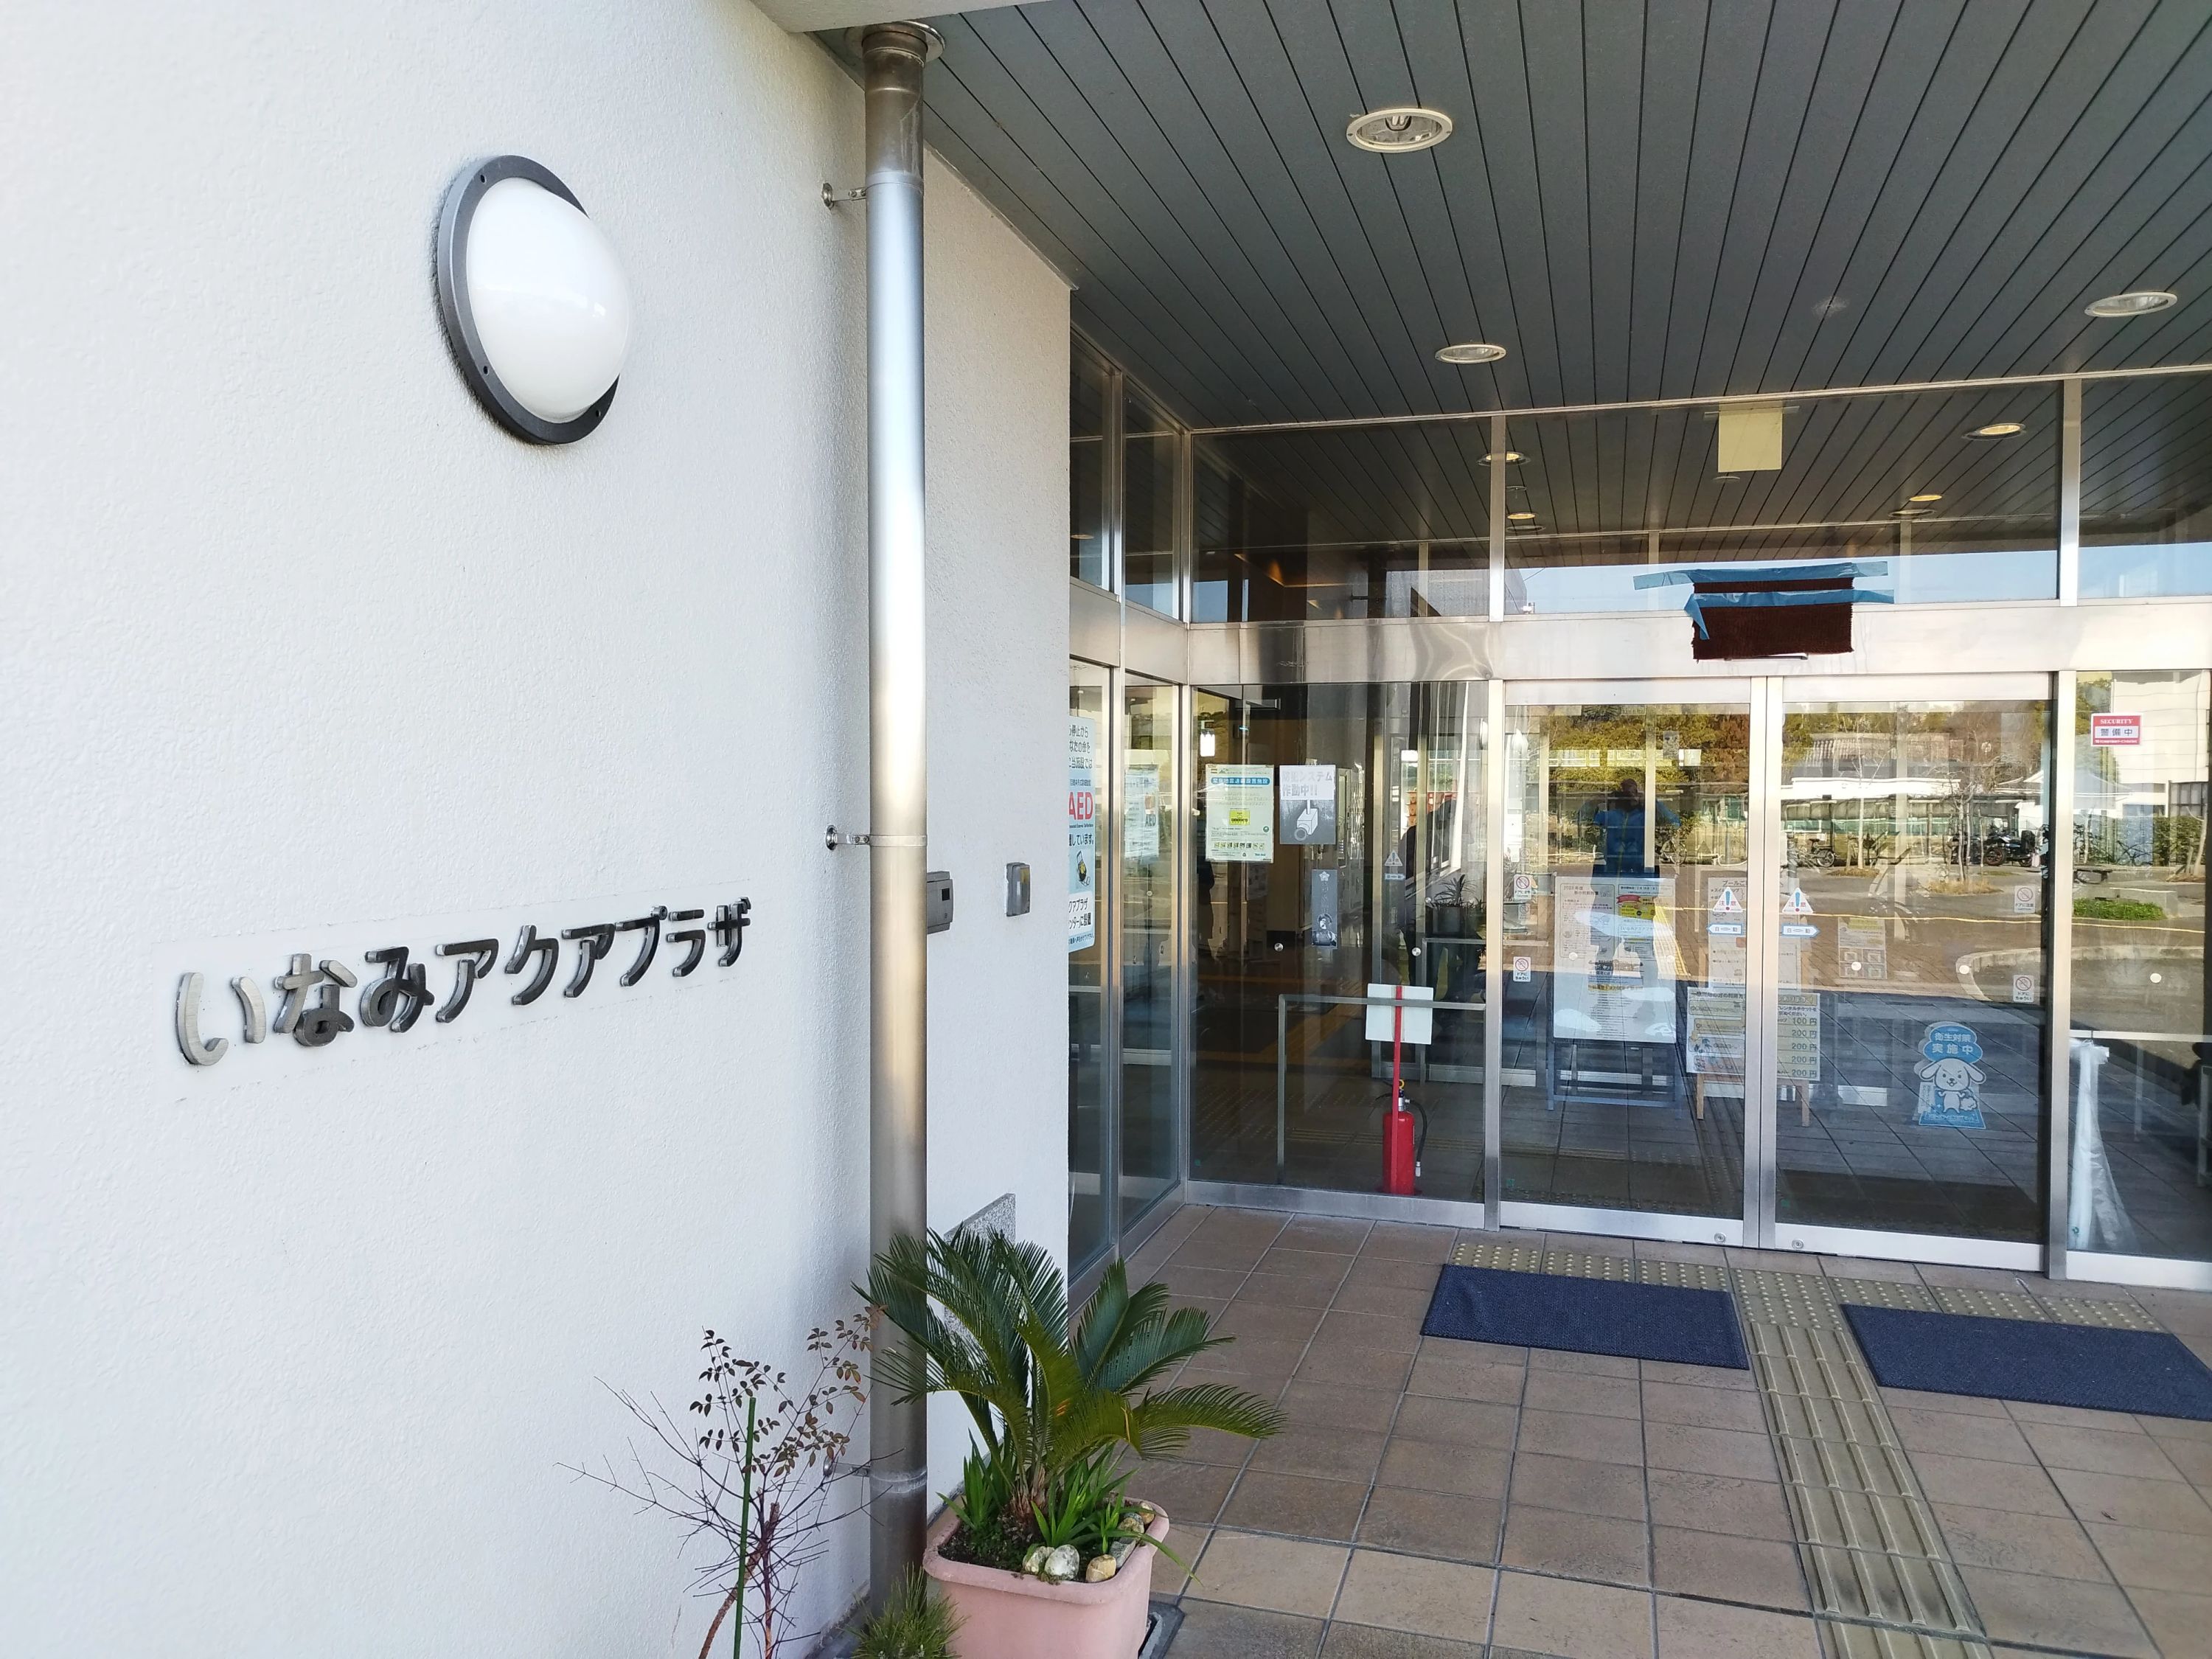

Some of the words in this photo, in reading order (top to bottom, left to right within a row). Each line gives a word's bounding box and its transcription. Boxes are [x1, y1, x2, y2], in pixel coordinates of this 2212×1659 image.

[1068, 792, 1093, 820] AED
[1144, 814, 1156, 827] AED
[175, 897, 751, 1067] いなみアクアプラザ
[1809, 1018, 1818, 1026] 円
[1935, 1032, 1972, 1043] 衛生対策
[1932, 1043, 1973, 1054] 実施中
[1809, 1070, 1818, 1079] 円
